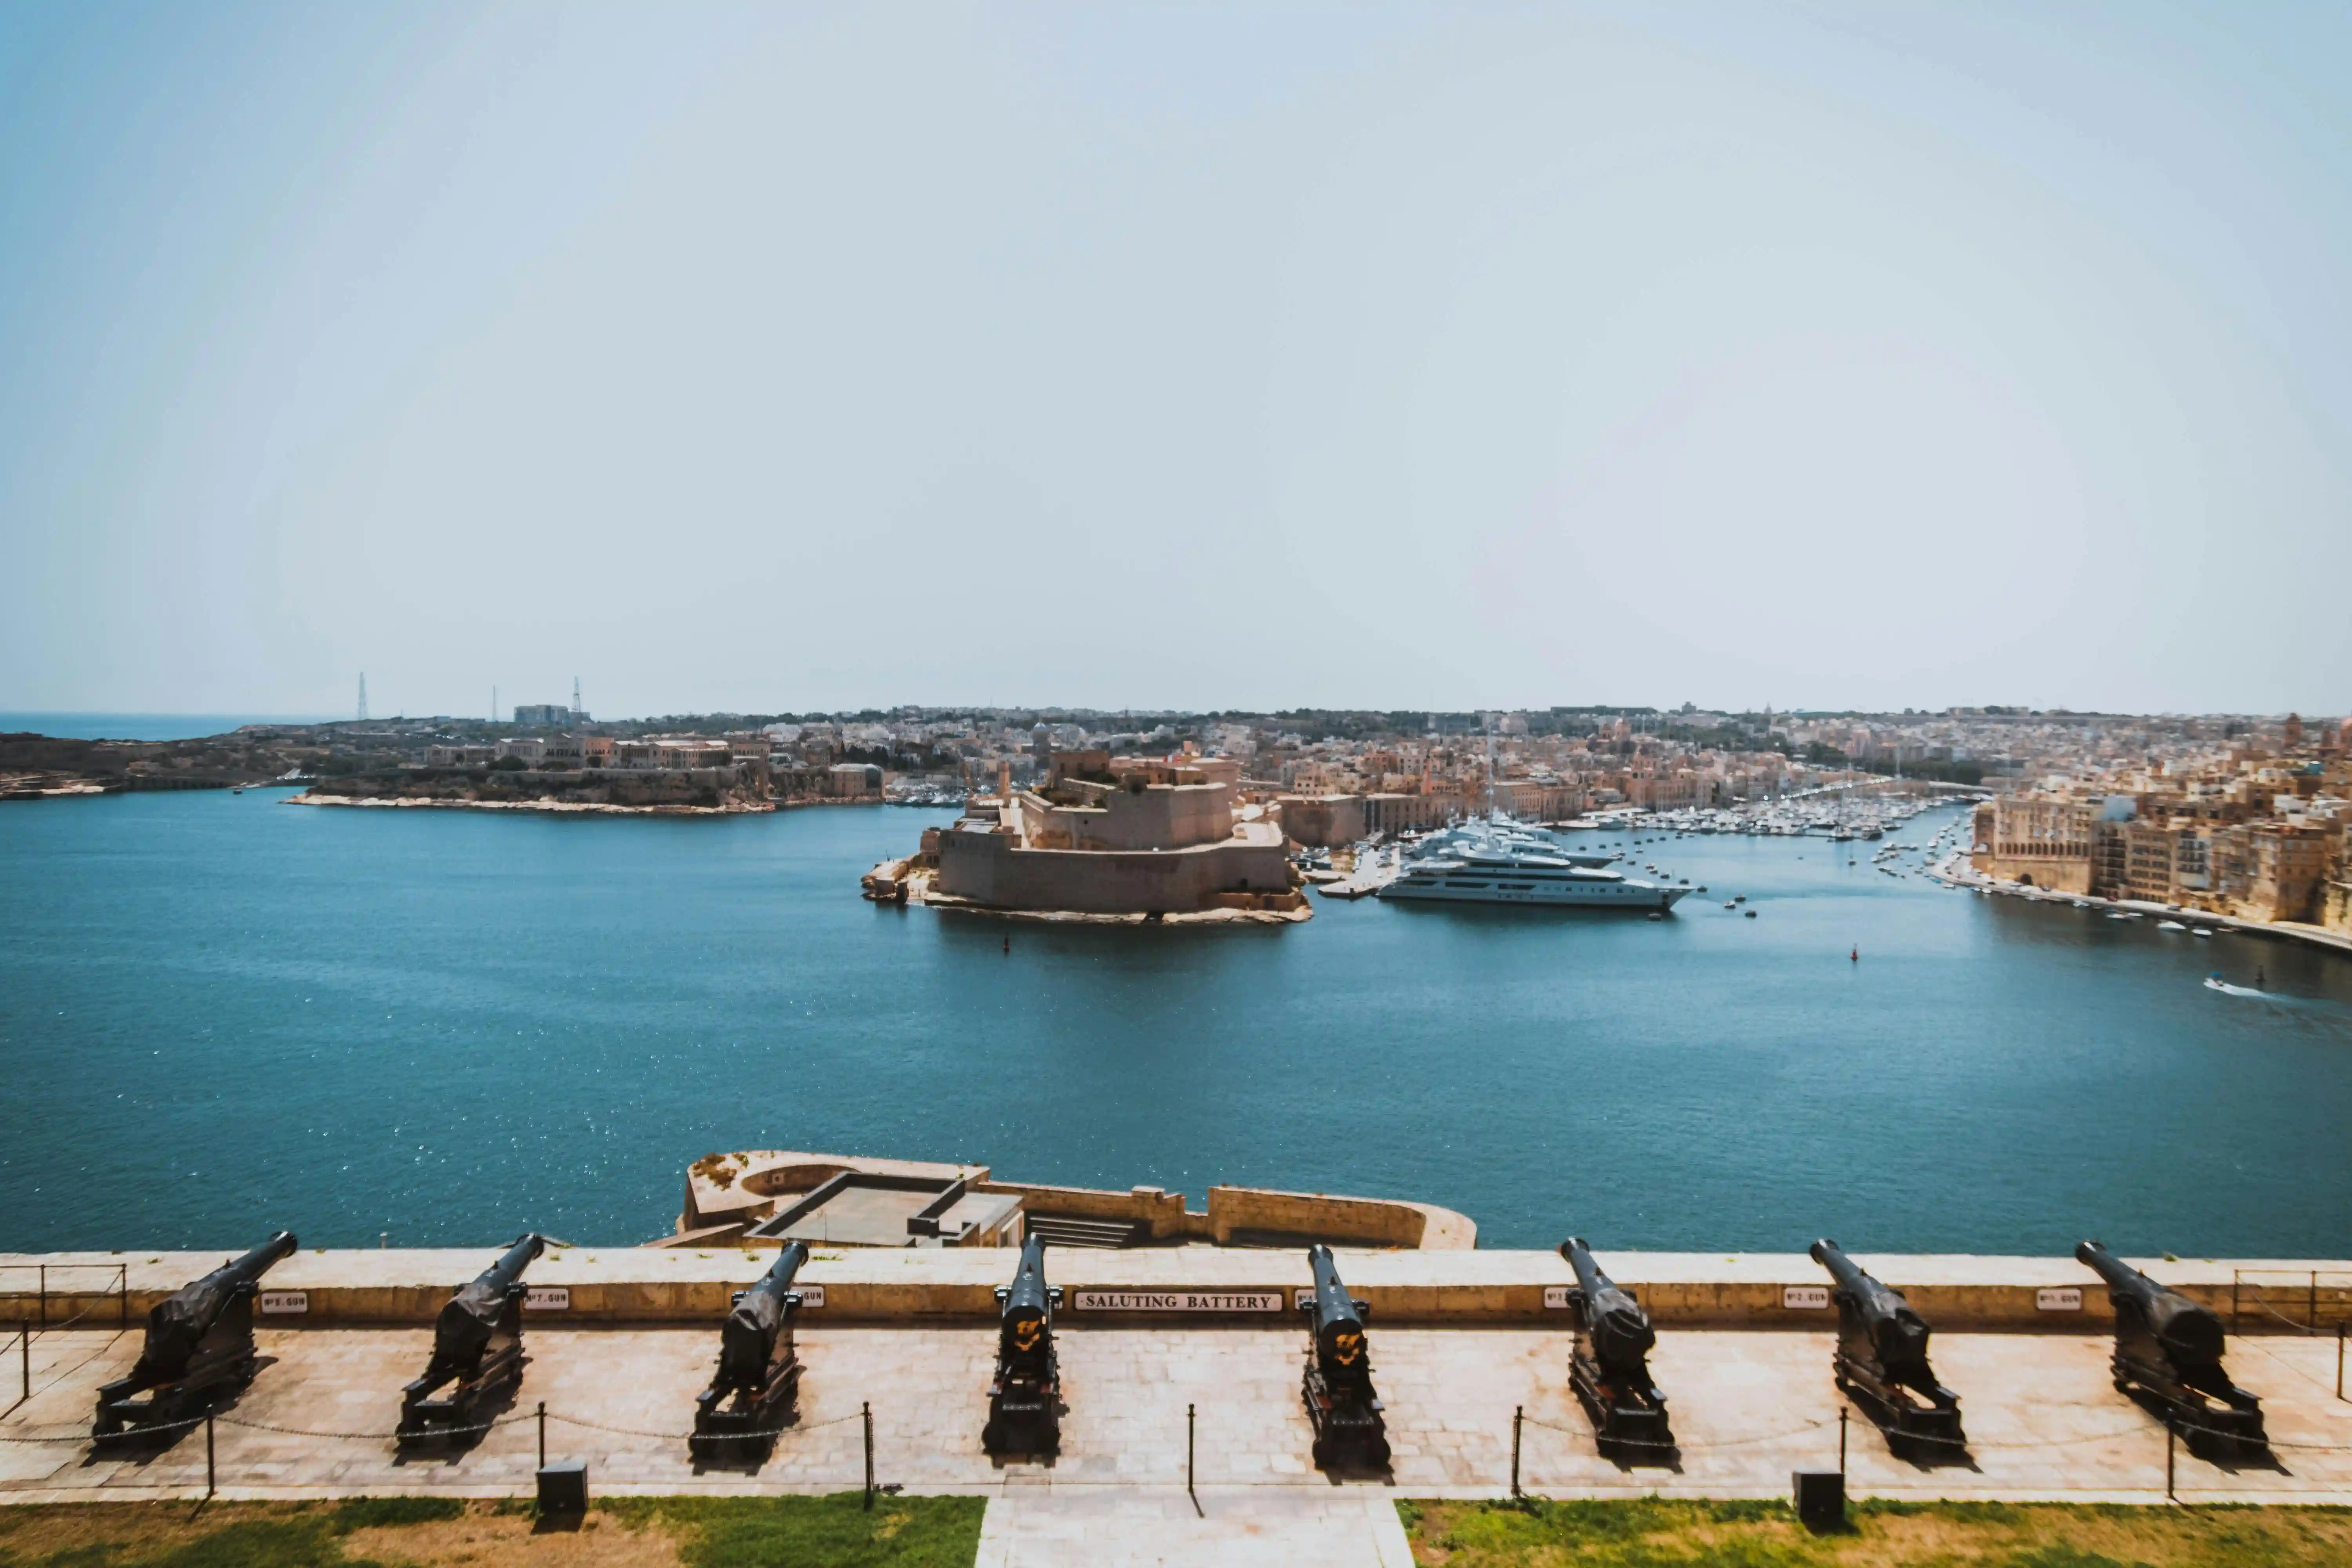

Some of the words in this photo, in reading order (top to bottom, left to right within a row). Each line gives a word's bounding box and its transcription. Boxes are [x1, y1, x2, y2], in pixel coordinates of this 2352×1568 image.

[286, 1298, 305, 1306] GUN
[548, 1294, 566, 1302] GUN
[1085, 1295, 1177, 1307] SALUTING
[1187, 1296, 1272, 1309] BATTERY
